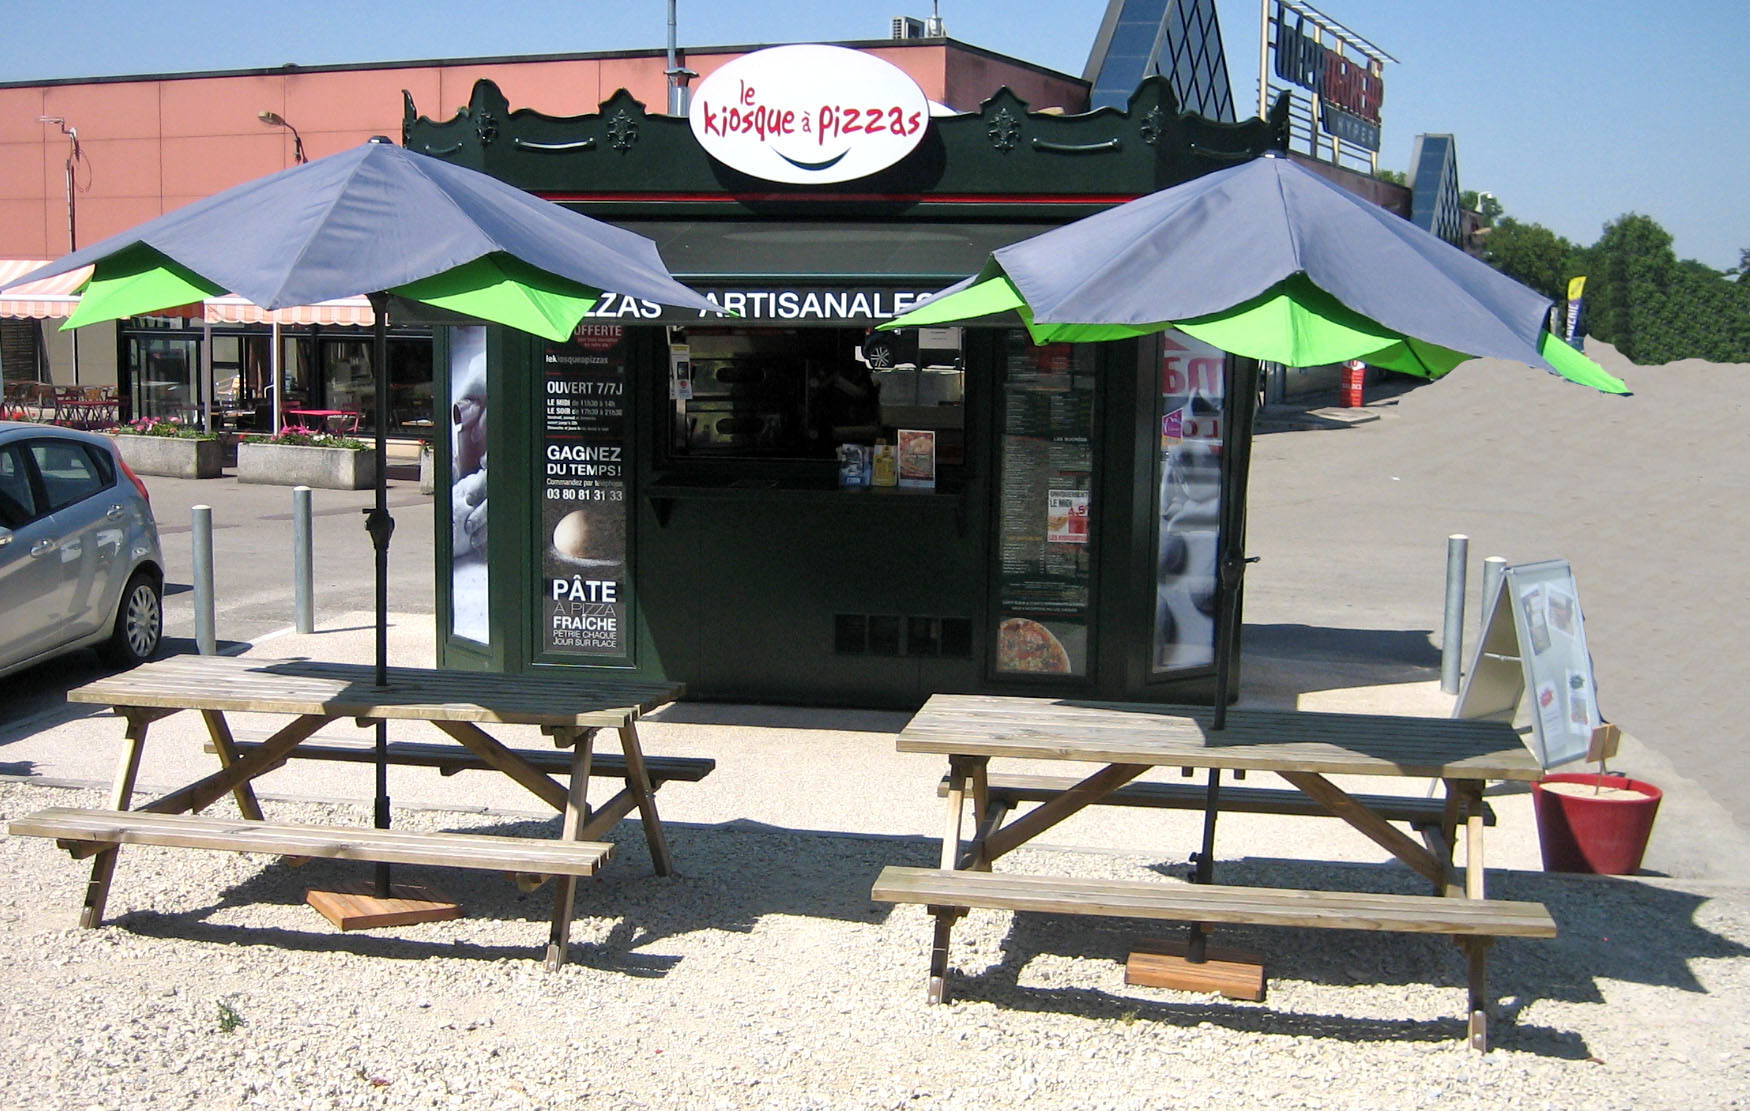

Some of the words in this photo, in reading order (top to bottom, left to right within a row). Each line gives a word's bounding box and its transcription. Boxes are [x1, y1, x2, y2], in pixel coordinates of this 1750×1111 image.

[741, 79, 755, 106] le
[704, 101, 794, 142] kiosque
[802, 111, 811, 133] à
[819, 105, 921, 146] pizzas
[583, 292, 662, 319] ZAS
[547, 381, 593, 394] OUVERT
[597, 382, 623, 395] 7/7J
[547, 445, 622, 462] GAGNEZ
[547, 463, 566, 475] DU
[547, 488, 560, 499] 03
[562, 489, 576, 500] 80
[578, 489, 590, 500] 81
[593, 490, 606, 500] 31
[609, 490, 623, 501] 33
[1050, 499, 1057, 508] LE
[553, 574, 617, 602] PÂTE
[571, 602, 616, 616] PIZZA
[582, 631, 616, 639] CHAQUE
[552, 637, 573, 646] JOUR
[575, 639, 591, 647] SUR
[592, 640, 616, 648] PLACE
